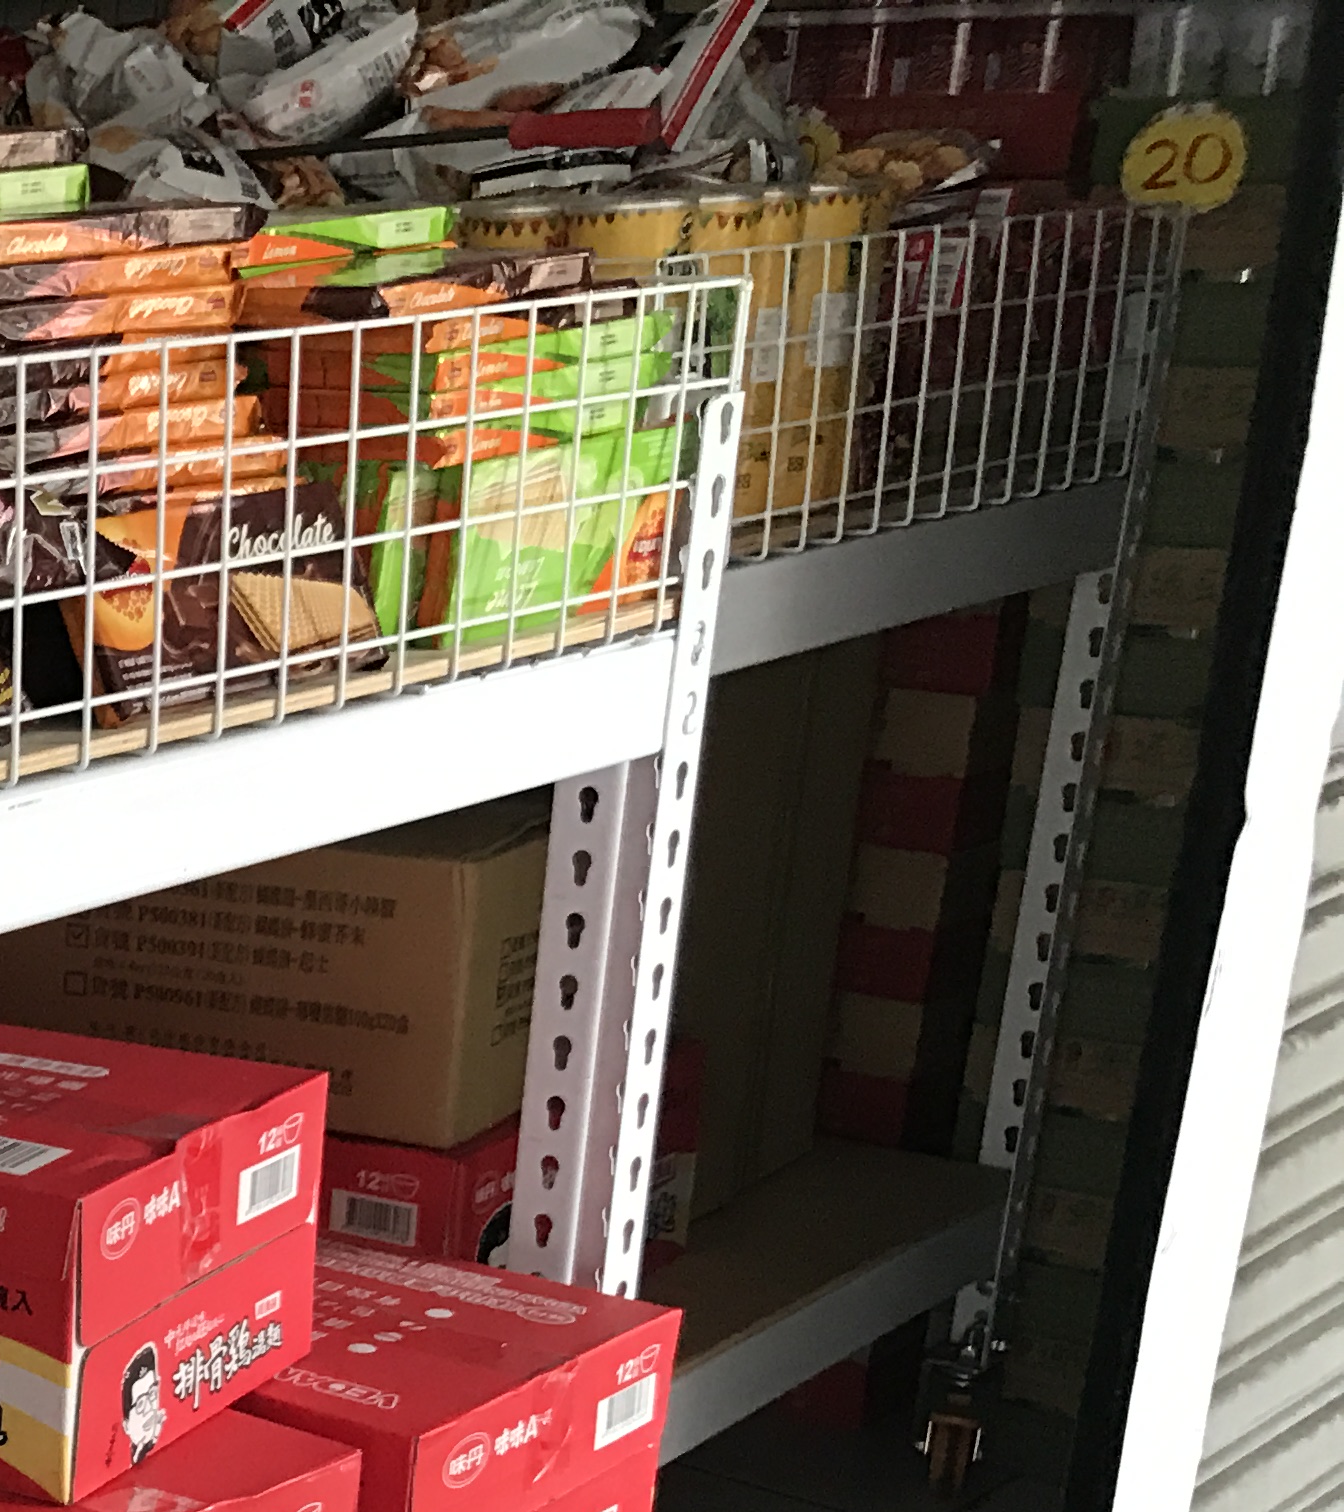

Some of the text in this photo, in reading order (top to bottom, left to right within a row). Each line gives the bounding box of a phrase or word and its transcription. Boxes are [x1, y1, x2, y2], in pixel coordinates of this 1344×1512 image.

[1140, 131, 1233, 191] 20
[227, 512, 336, 562] Chocolate
[104, 1212, 137, 1248] 味丹
[447, 1442, 486, 1478] 味丹
